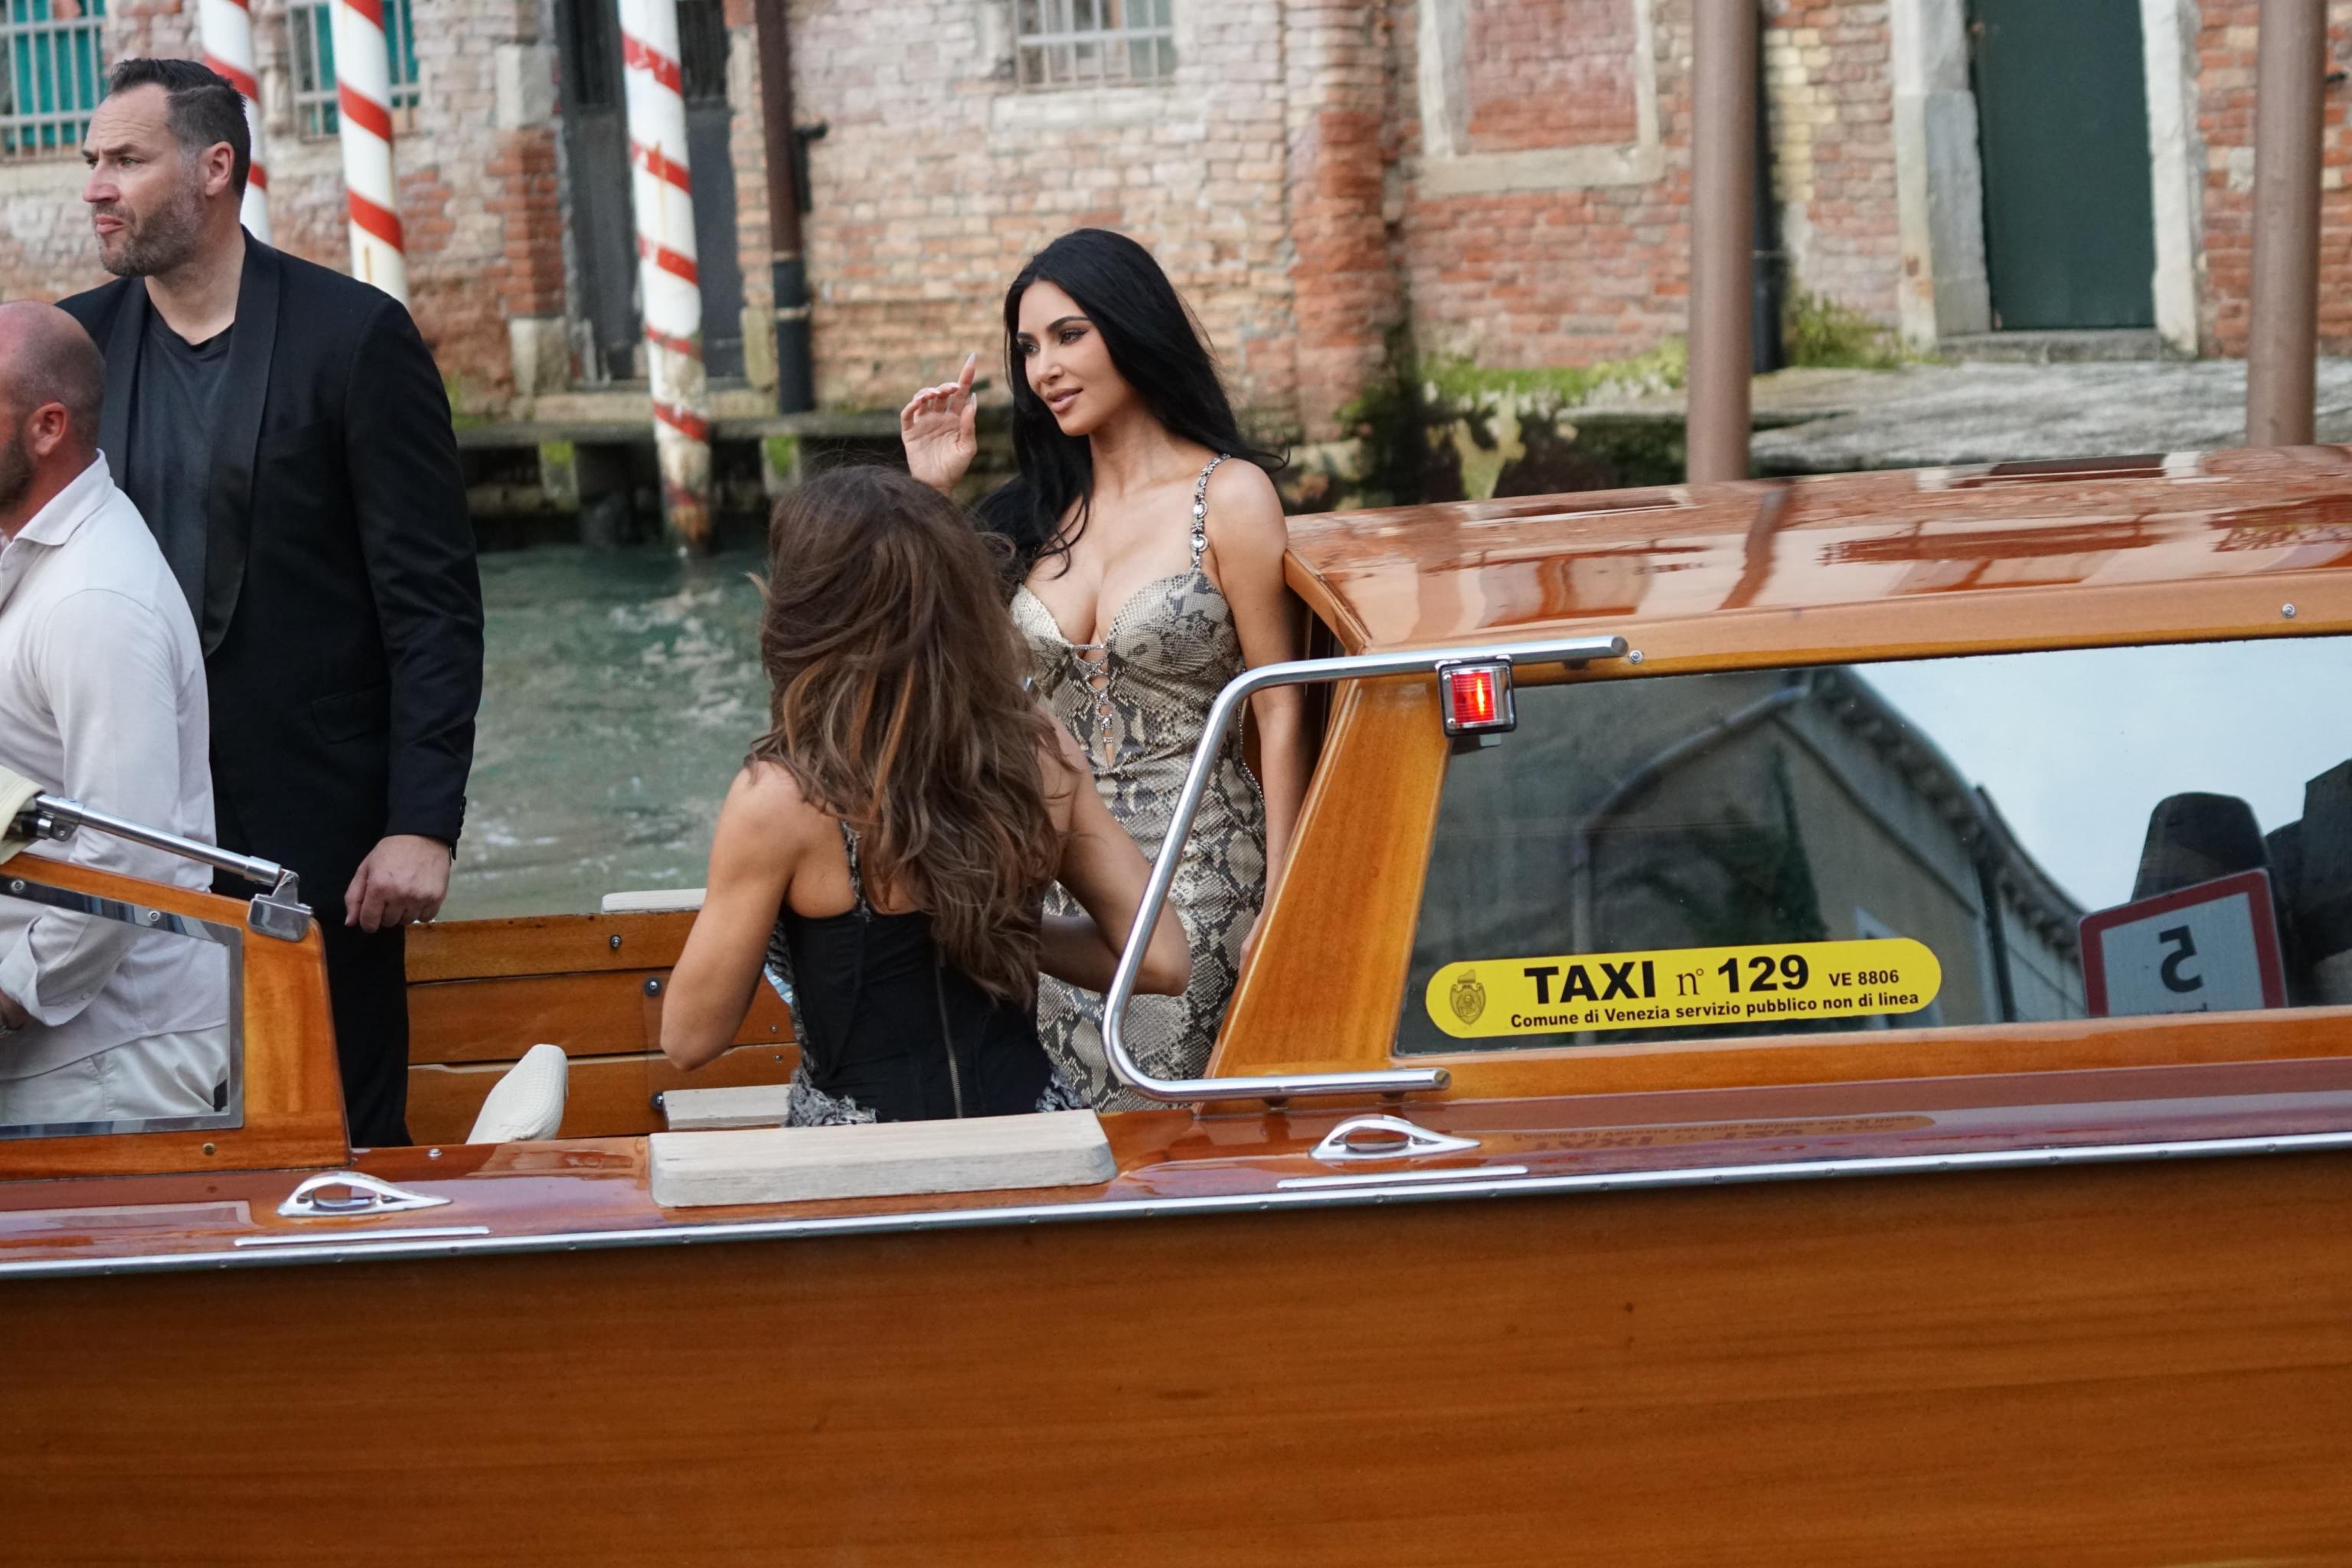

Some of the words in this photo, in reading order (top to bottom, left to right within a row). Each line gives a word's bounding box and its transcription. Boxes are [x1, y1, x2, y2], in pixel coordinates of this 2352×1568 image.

[1524, 960, 1656, 1004] TAXI
[1717, 954, 1809, 993] 129
[1828, 972, 1852, 987] VE
[1858, 969, 1900, 985] 8806
[1511, 1014, 1579, 1028] Comune
[1584, 1009, 1599, 1024] di
[1604, 1006, 1670, 1022] Venezia
[1675, 1001, 1741, 1018] servizio
[1746, 997, 1817, 1018] pubblico
[1823, 998, 1853, 1009] non
[1858, 993, 1873, 1008] di
[1878, 991, 1919, 1006] linea
